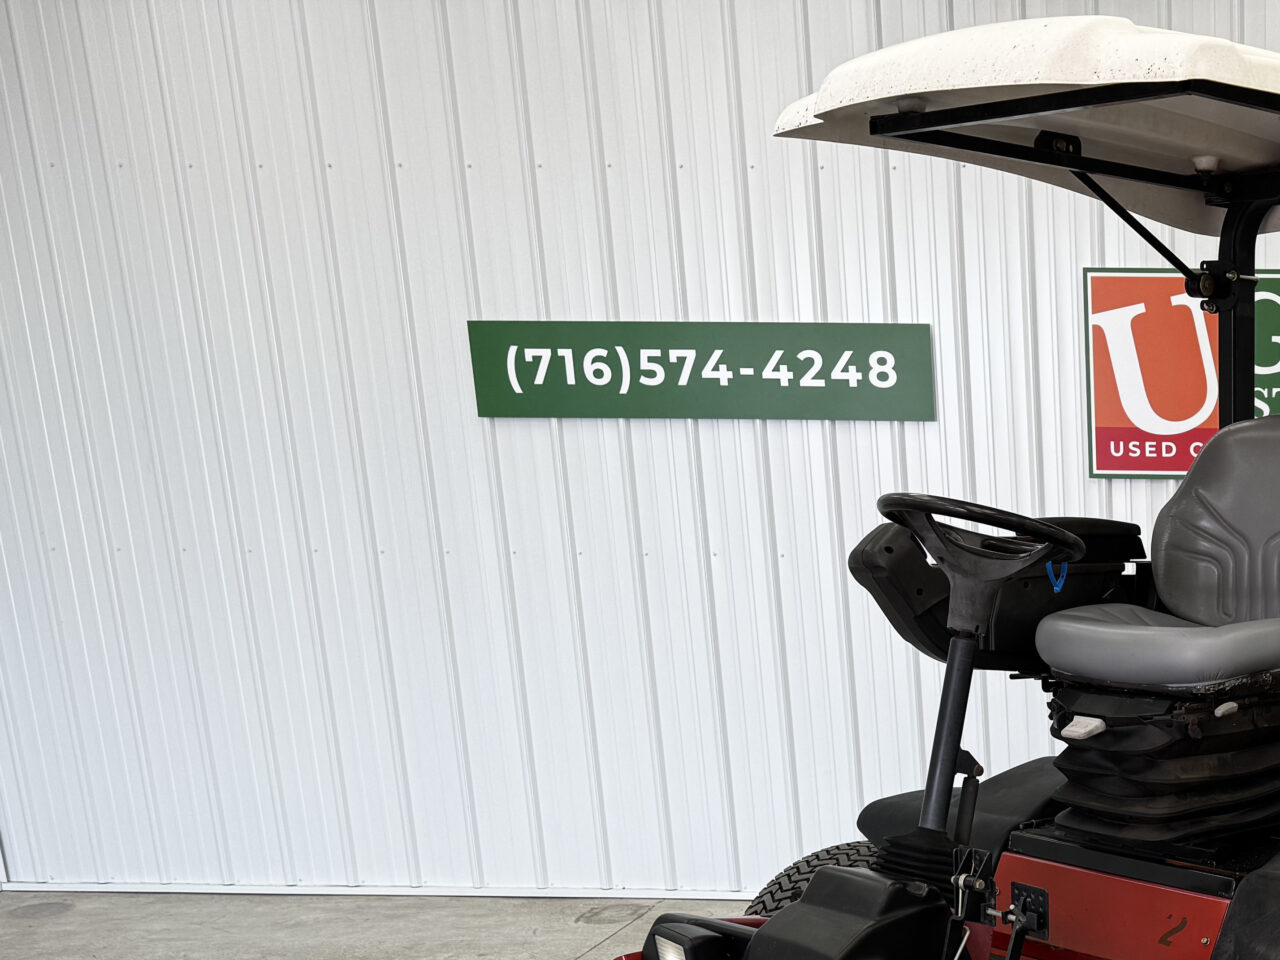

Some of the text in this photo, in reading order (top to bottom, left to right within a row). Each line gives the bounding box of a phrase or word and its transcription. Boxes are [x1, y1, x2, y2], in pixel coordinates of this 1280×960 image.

[506, 345, 898, 395] (716)574-4248
[1109, 440, 1177, 458] USED
[1158, 913, 1188, 947] 2
